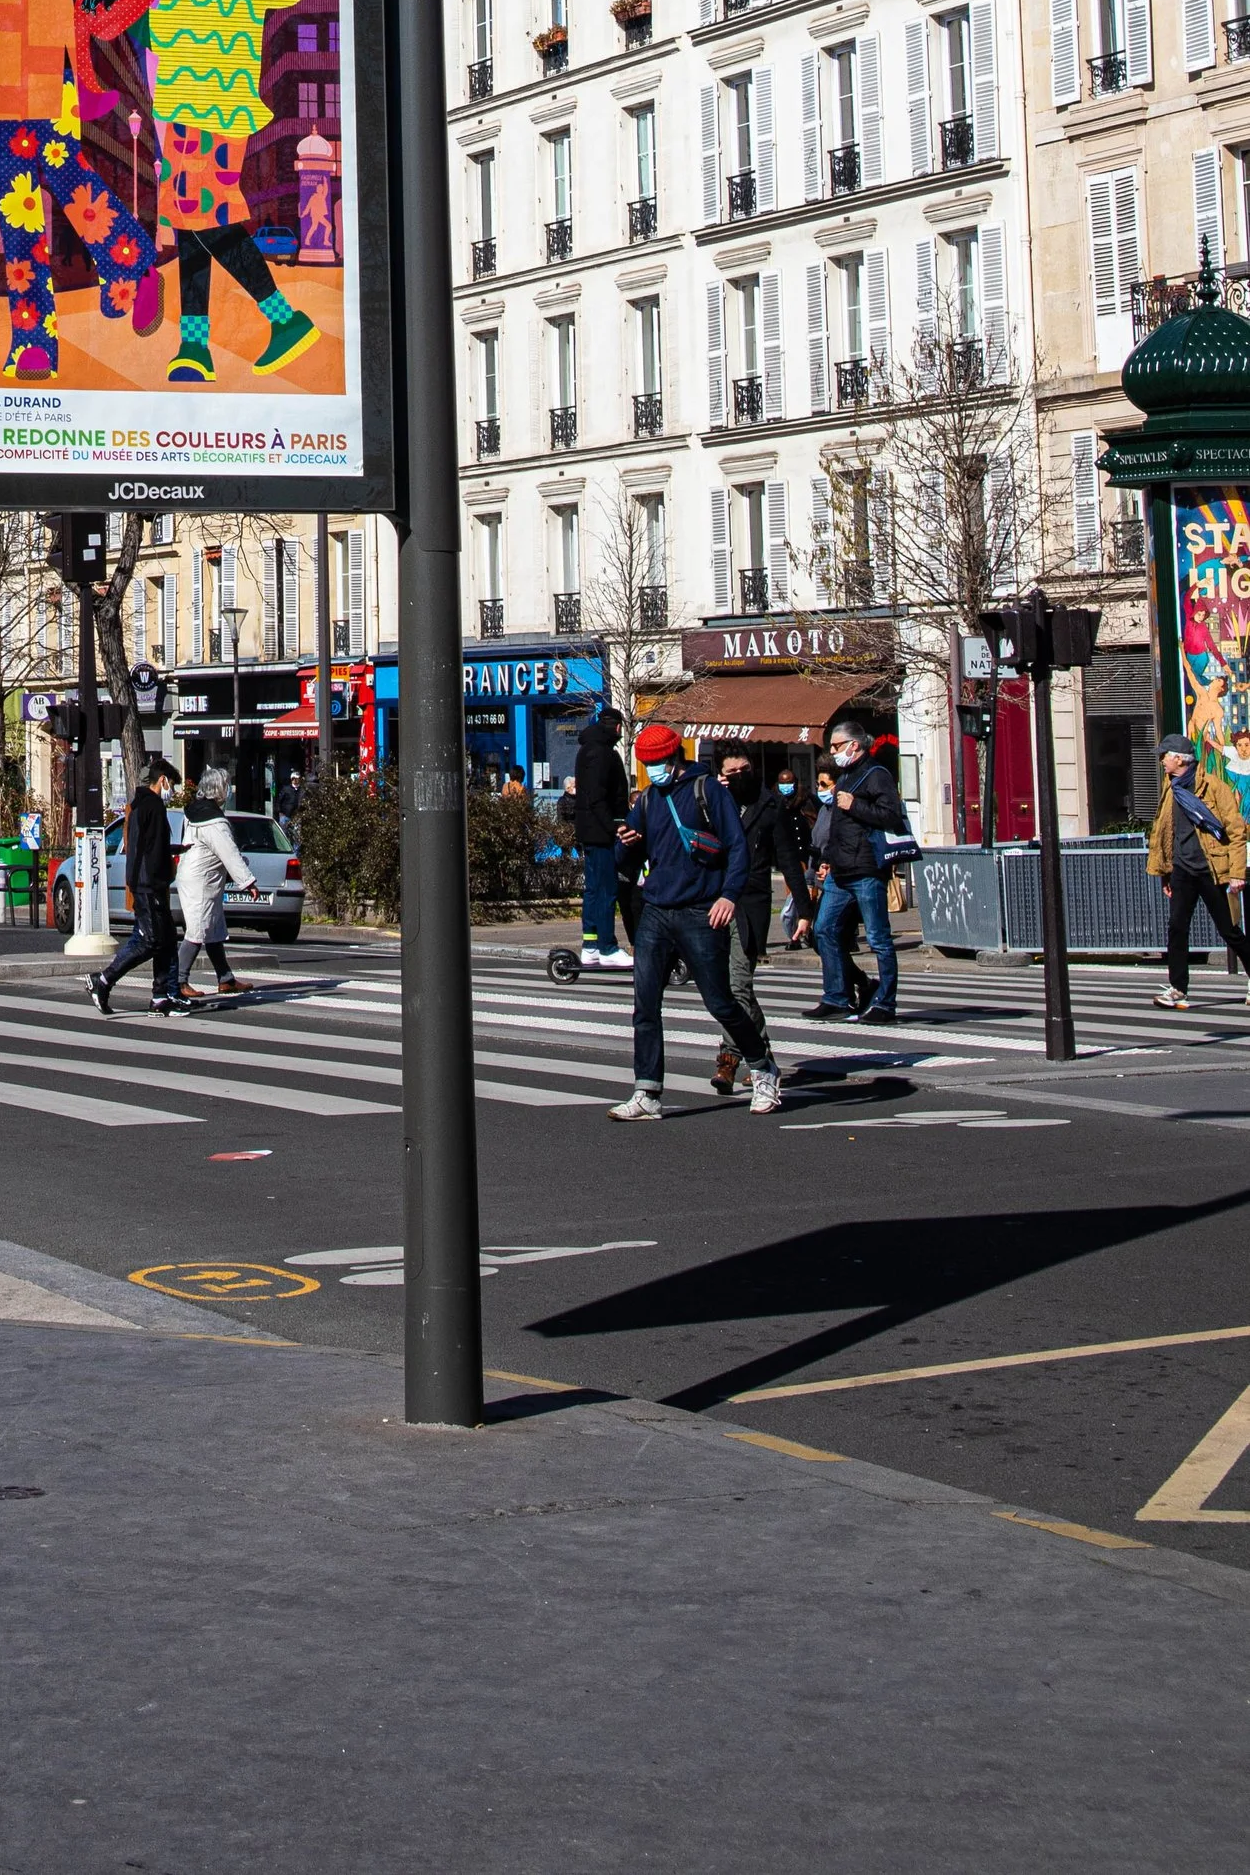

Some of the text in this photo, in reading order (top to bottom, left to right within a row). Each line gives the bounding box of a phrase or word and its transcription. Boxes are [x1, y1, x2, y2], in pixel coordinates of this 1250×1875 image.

[4, 396, 62, 408] DURAND
[5, 411, 33, 422] D'ÉTÉ
[35, 411, 42, 422] À
[44, 413, 72, 423] PARIS
[3, 428, 106, 446] REDONNE
[112, 430, 151, 447] DES
[156, 431, 266, 449] COULEURS
[270, 428, 286, 449] À
[290, 433, 347, 450] PARIS
[72, 450, 89, 460] DU
[92, 448, 133, 461] MUSÉE
[136, 451, 158, 462] DES
[161, 452, 190, 462] ARTS
[193, 450, 265, 463] DÉCORATIFS
[268, 453, 282, 464] ET
[284, 454, 347, 465] JCDECAUX
[1119, 451, 1168, 465] SPECTACLES
[108, 482, 205, 500] JCDecaux
[723, 628, 844, 658] MAKOTO
[463, 661, 566, 693] RANCES
[683, 724, 755, 739] 01 44 64 75 87
